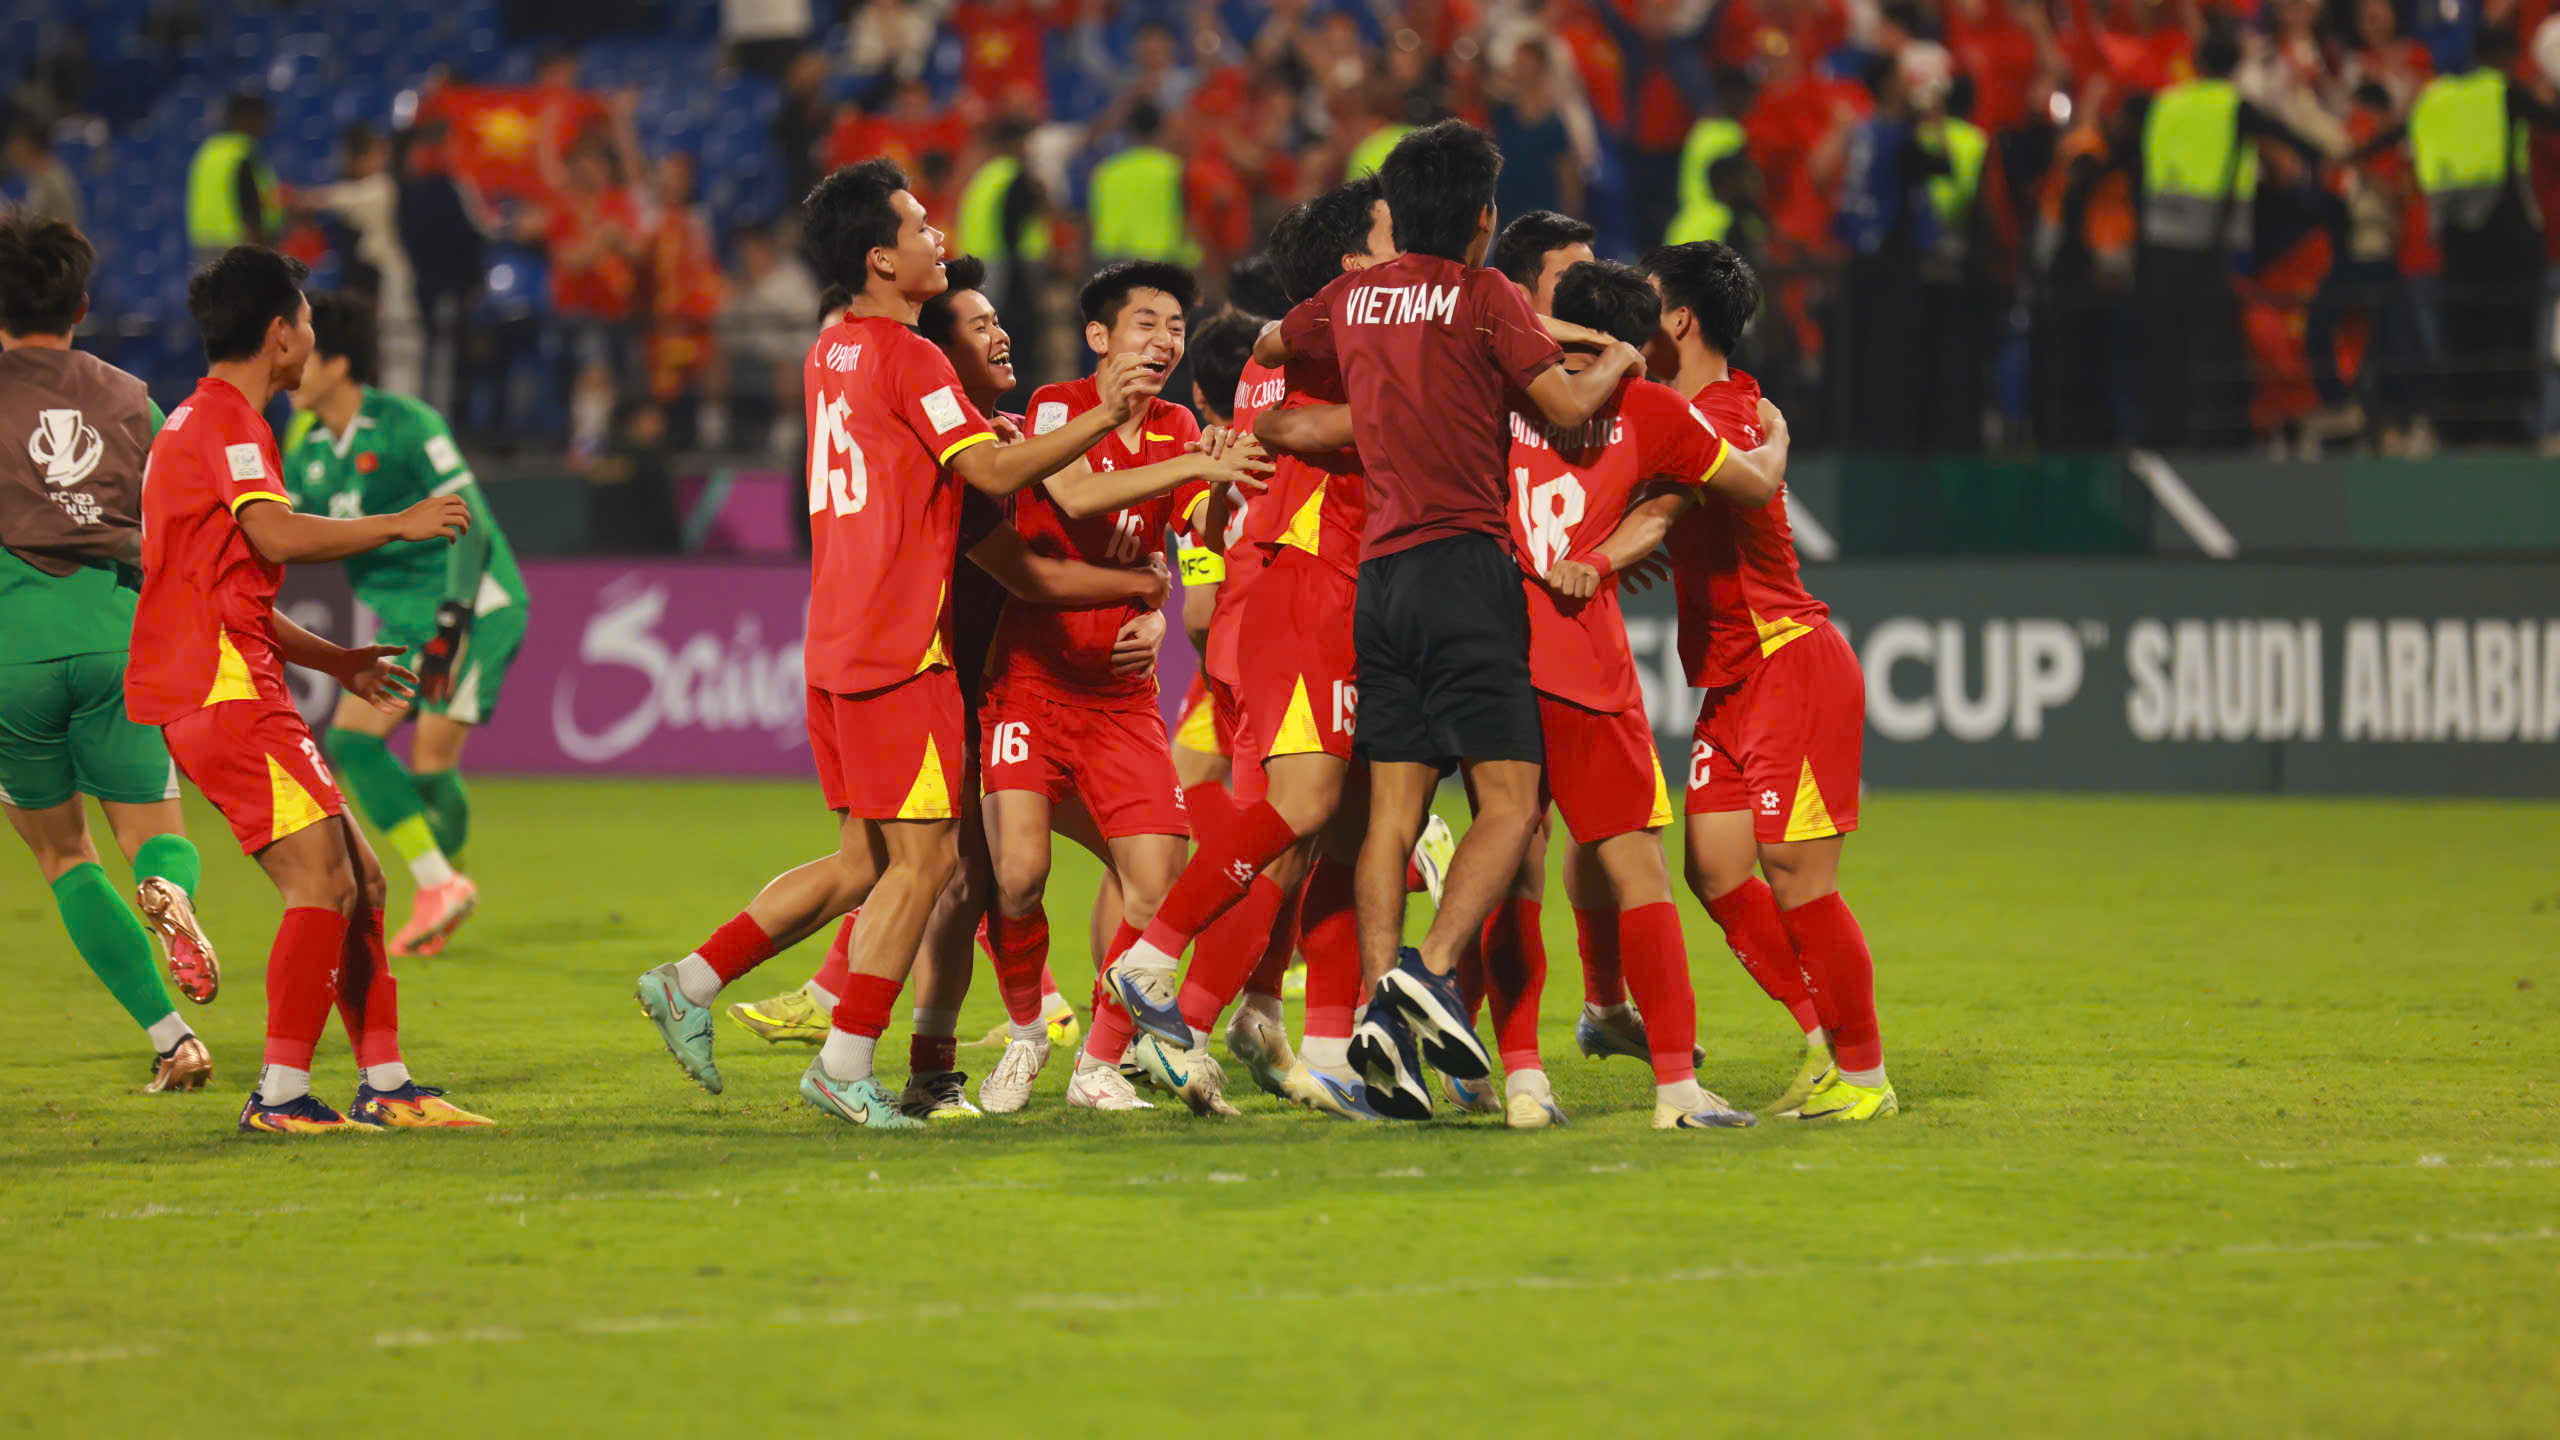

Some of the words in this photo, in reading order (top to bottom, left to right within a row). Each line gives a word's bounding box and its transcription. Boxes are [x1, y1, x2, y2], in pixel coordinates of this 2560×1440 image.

[1346, 283, 1460, 326] VIETNAM
[809, 388, 868, 518] 15
[1104, 508, 1144, 564] 16
[1514, 466, 1586, 579] 18
[2126, 617, 2324, 743] SAUDI
[991, 720, 1031, 768] 16
